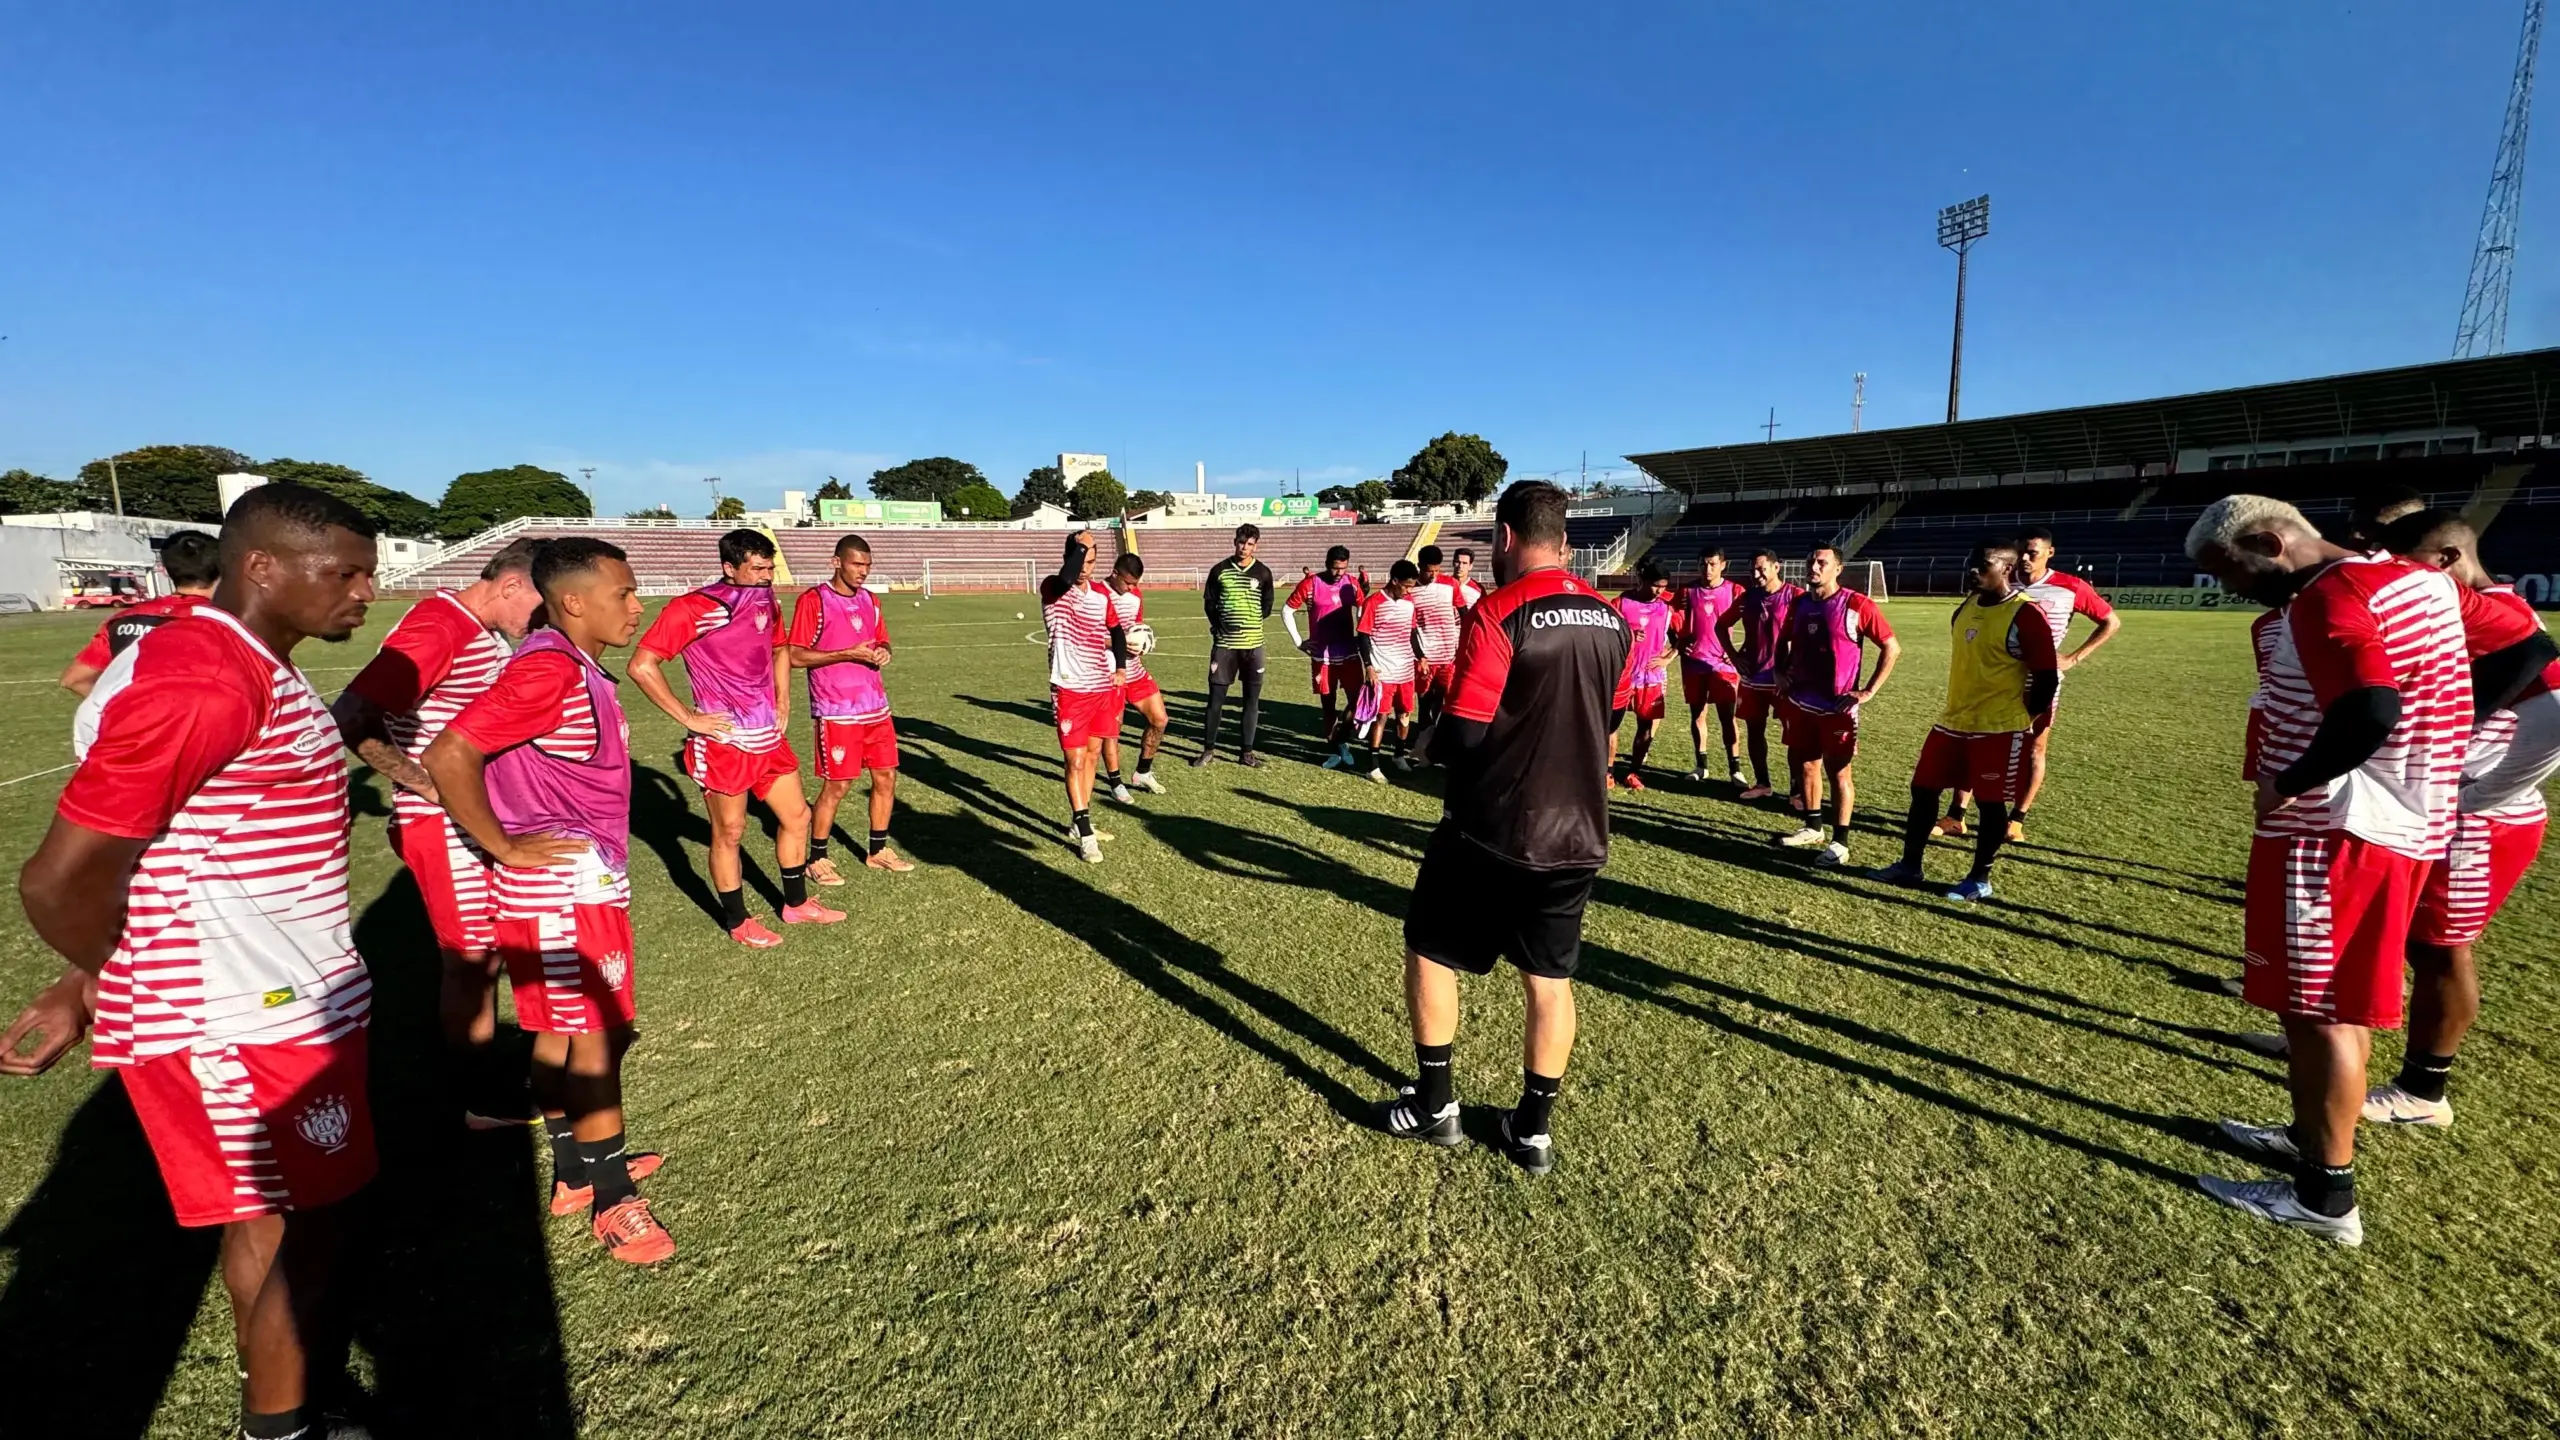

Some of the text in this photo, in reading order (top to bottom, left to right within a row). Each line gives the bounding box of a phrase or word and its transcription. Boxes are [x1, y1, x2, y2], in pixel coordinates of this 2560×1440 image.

[1230, 502, 1258, 511] boss
[2180, 594, 2194, 605] D
[1531, 608, 1620, 631] COMISSÃO
